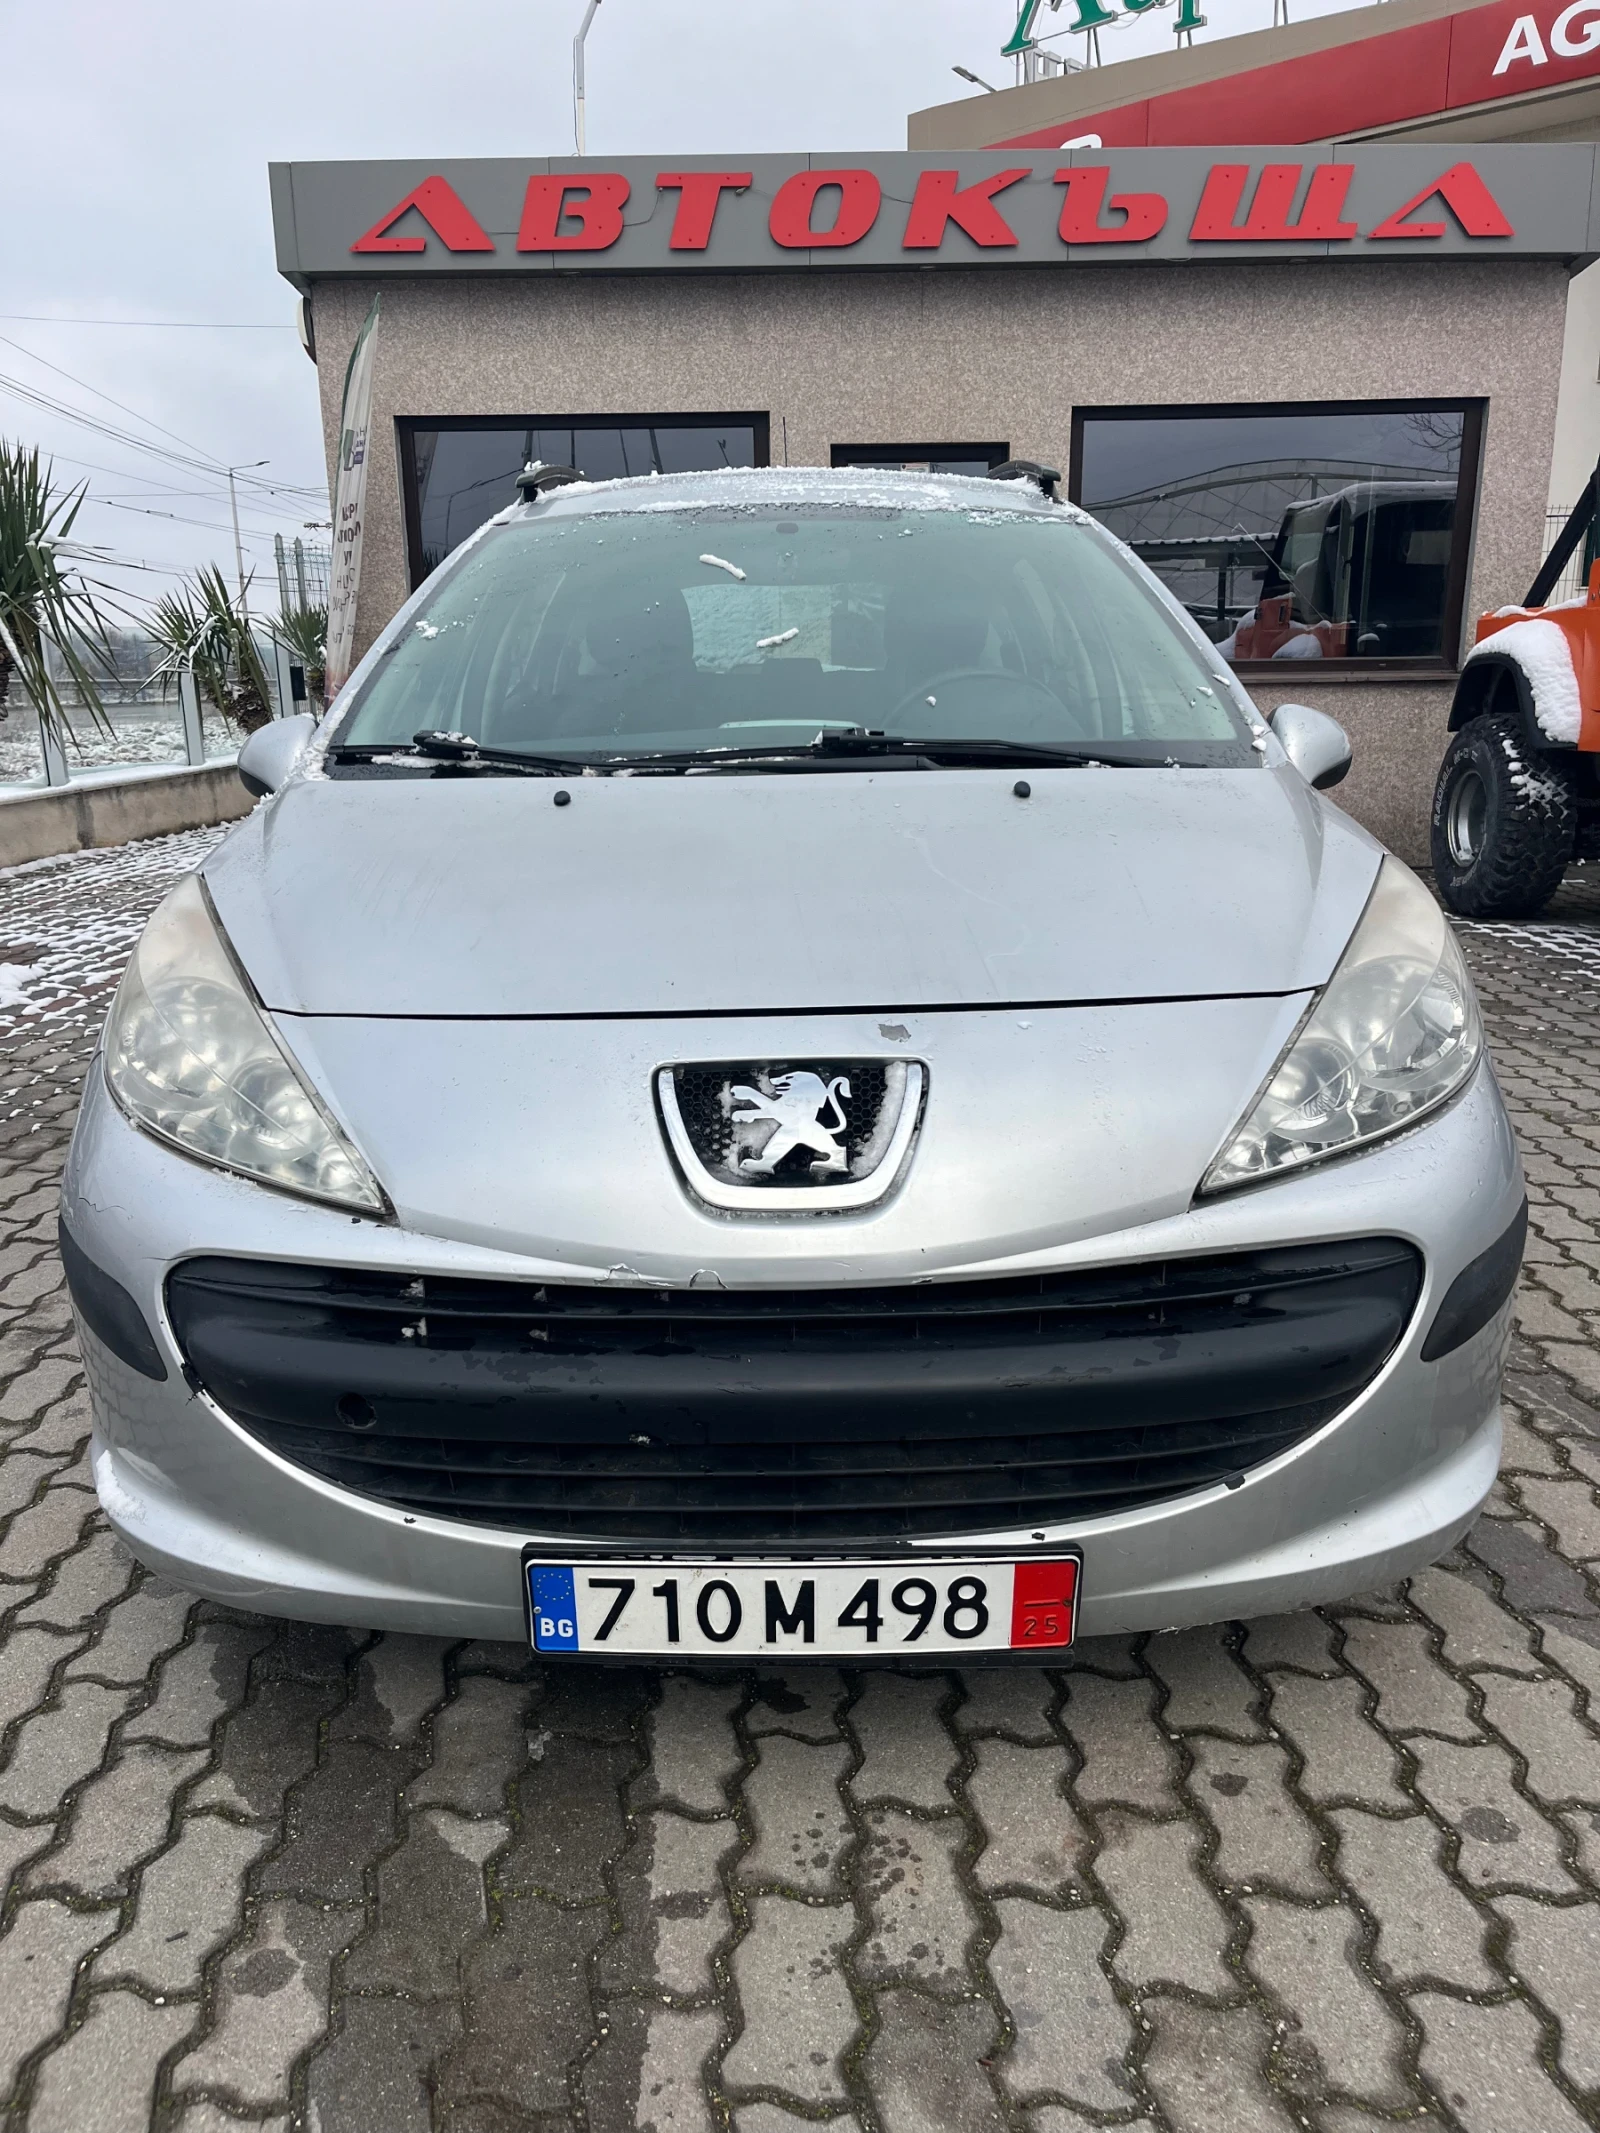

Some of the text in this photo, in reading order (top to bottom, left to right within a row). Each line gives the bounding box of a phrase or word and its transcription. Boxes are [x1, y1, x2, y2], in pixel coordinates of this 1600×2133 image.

[349, 162, 1515, 253] АВТОКЪЩА
[540, 1617, 574, 1638] BG
[588, 1576, 989, 1643] 710 M 498
[1024, 1614, 1059, 1637] 25
